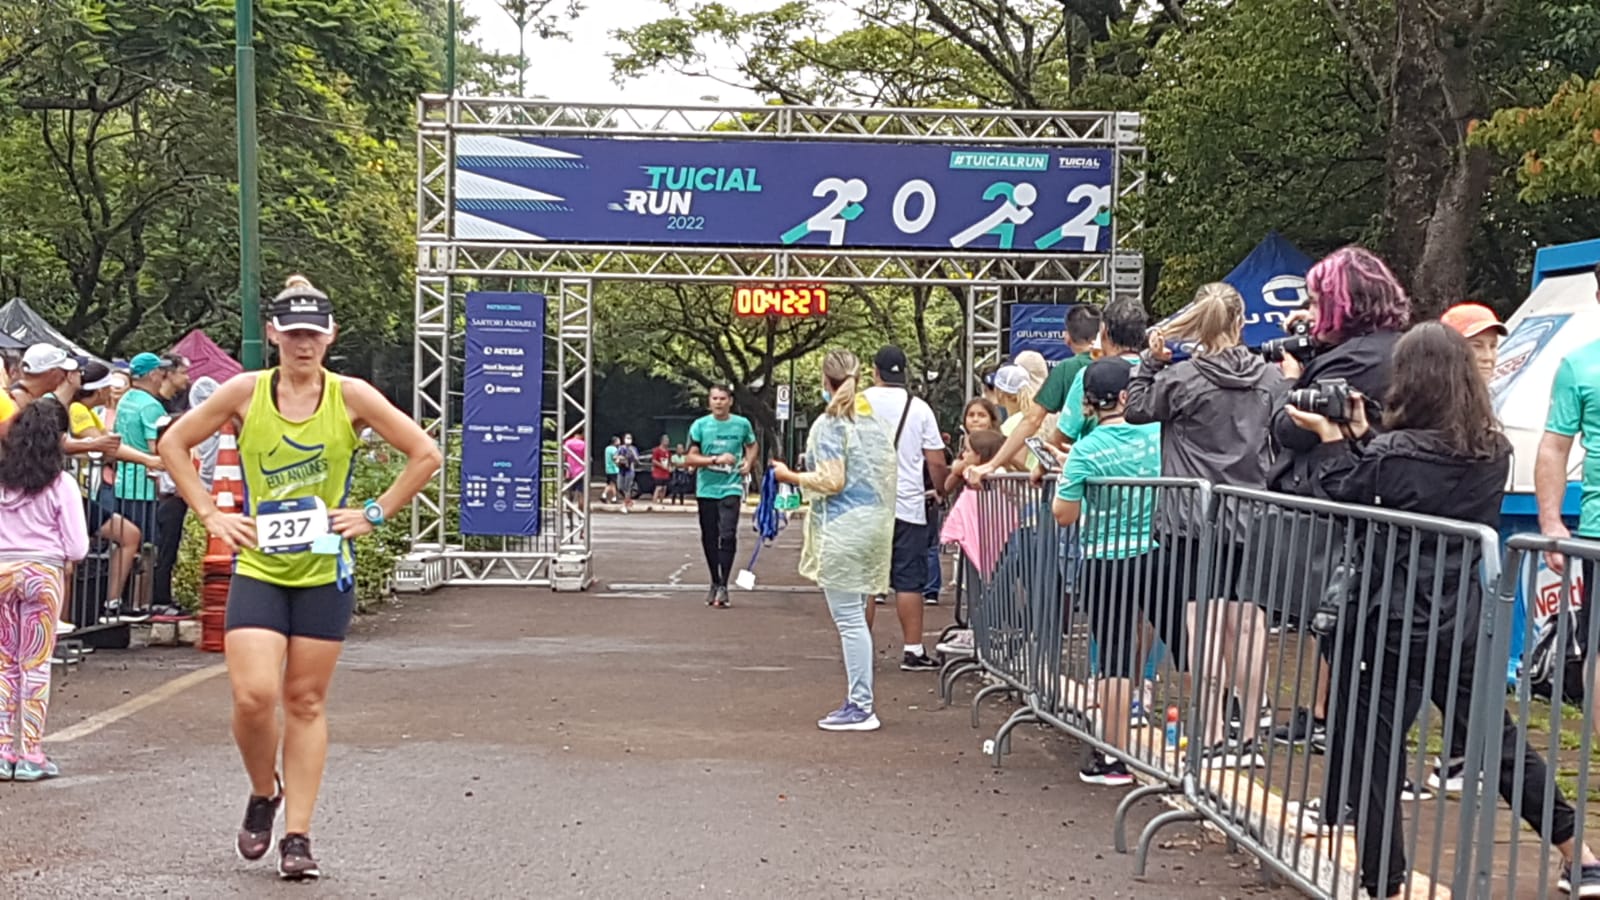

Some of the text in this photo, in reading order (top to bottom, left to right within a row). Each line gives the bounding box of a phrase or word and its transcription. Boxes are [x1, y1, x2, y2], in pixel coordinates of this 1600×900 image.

[953, 154, 1045, 169] #TUICIALRUN
[1059, 157, 1101, 167] TUICIAL
[644, 165, 762, 191] TUICIAL
[624, 190, 692, 215] RUN
[666, 216, 705, 230] 2022
[287, 458, 329, 481] ANTUNES
[268, 517, 311, 540] 237
